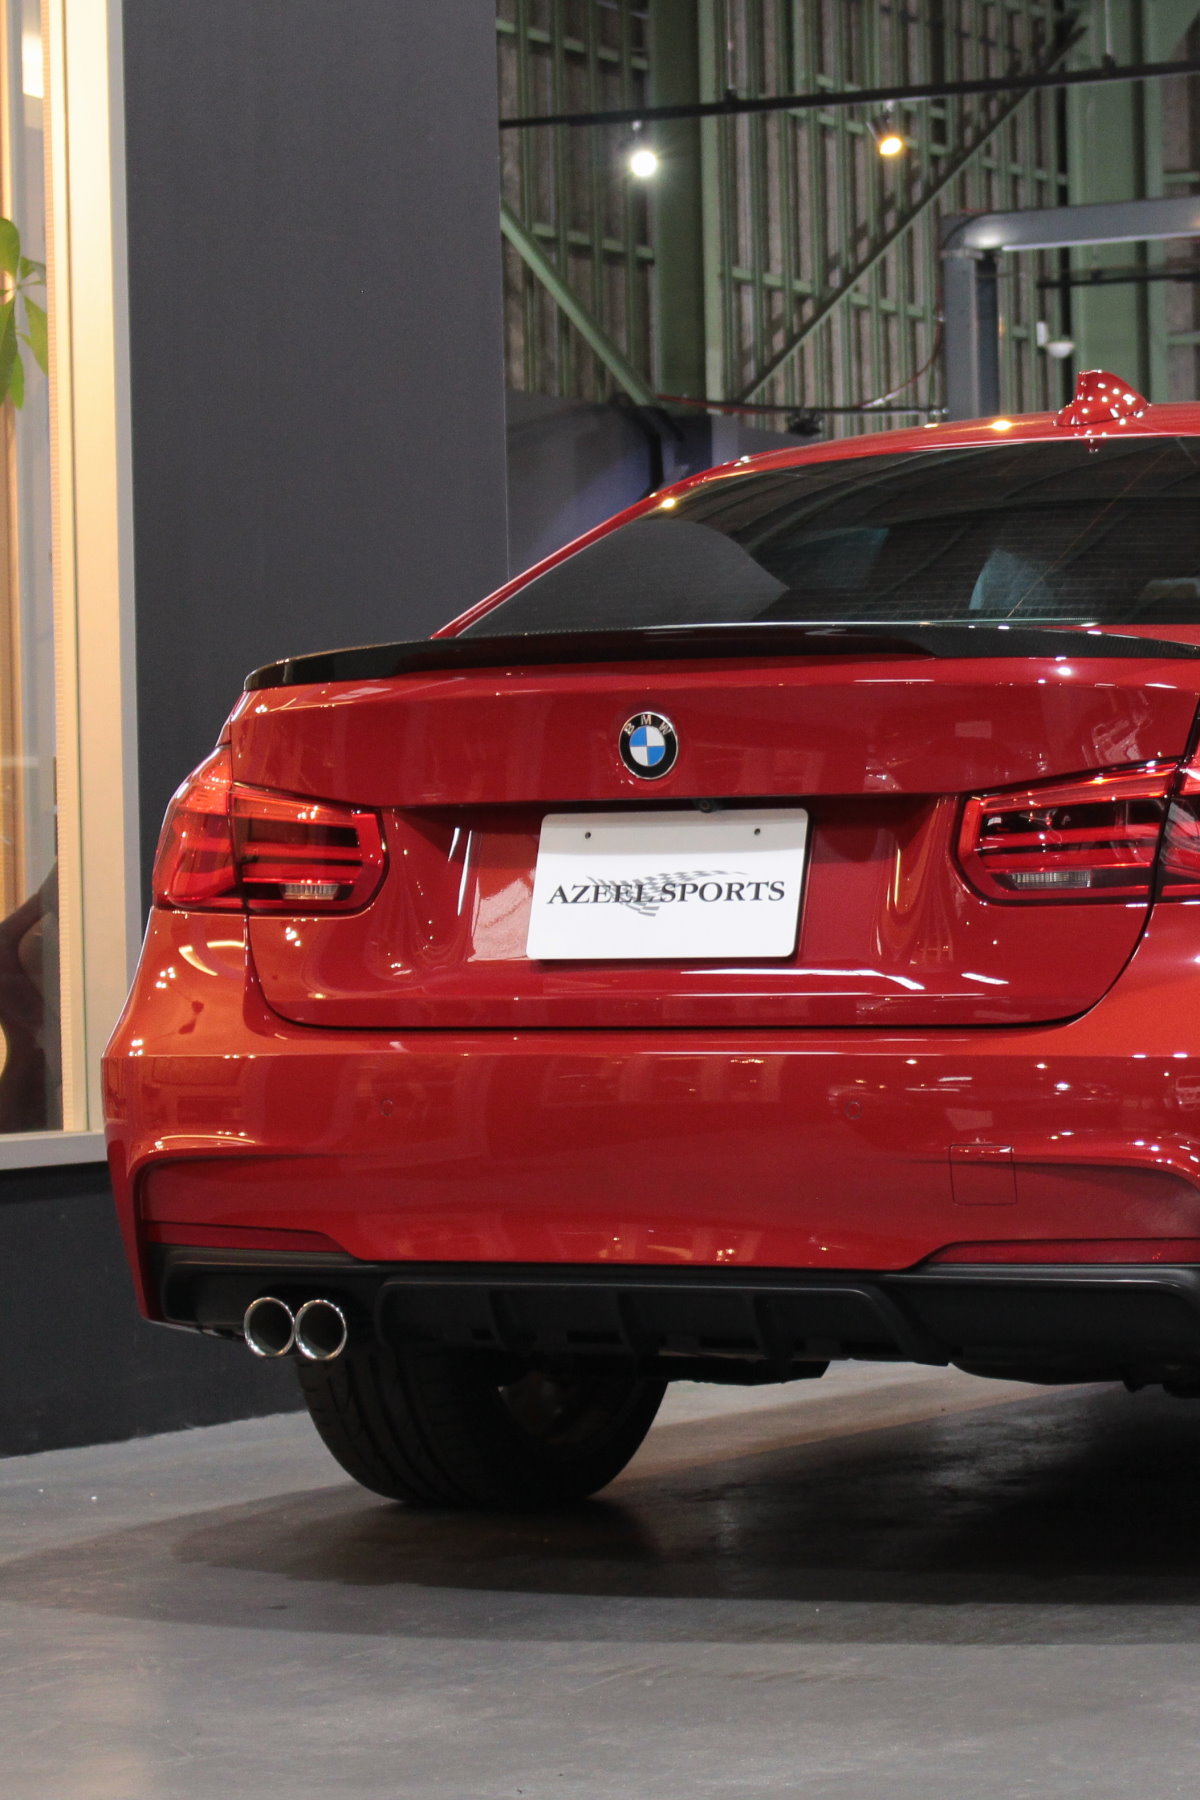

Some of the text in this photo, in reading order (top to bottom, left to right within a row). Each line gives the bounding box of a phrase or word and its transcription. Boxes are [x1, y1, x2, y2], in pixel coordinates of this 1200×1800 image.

[624, 714, 673, 736] BMW
[547, 881, 785, 904] AZEEL SPORTS
